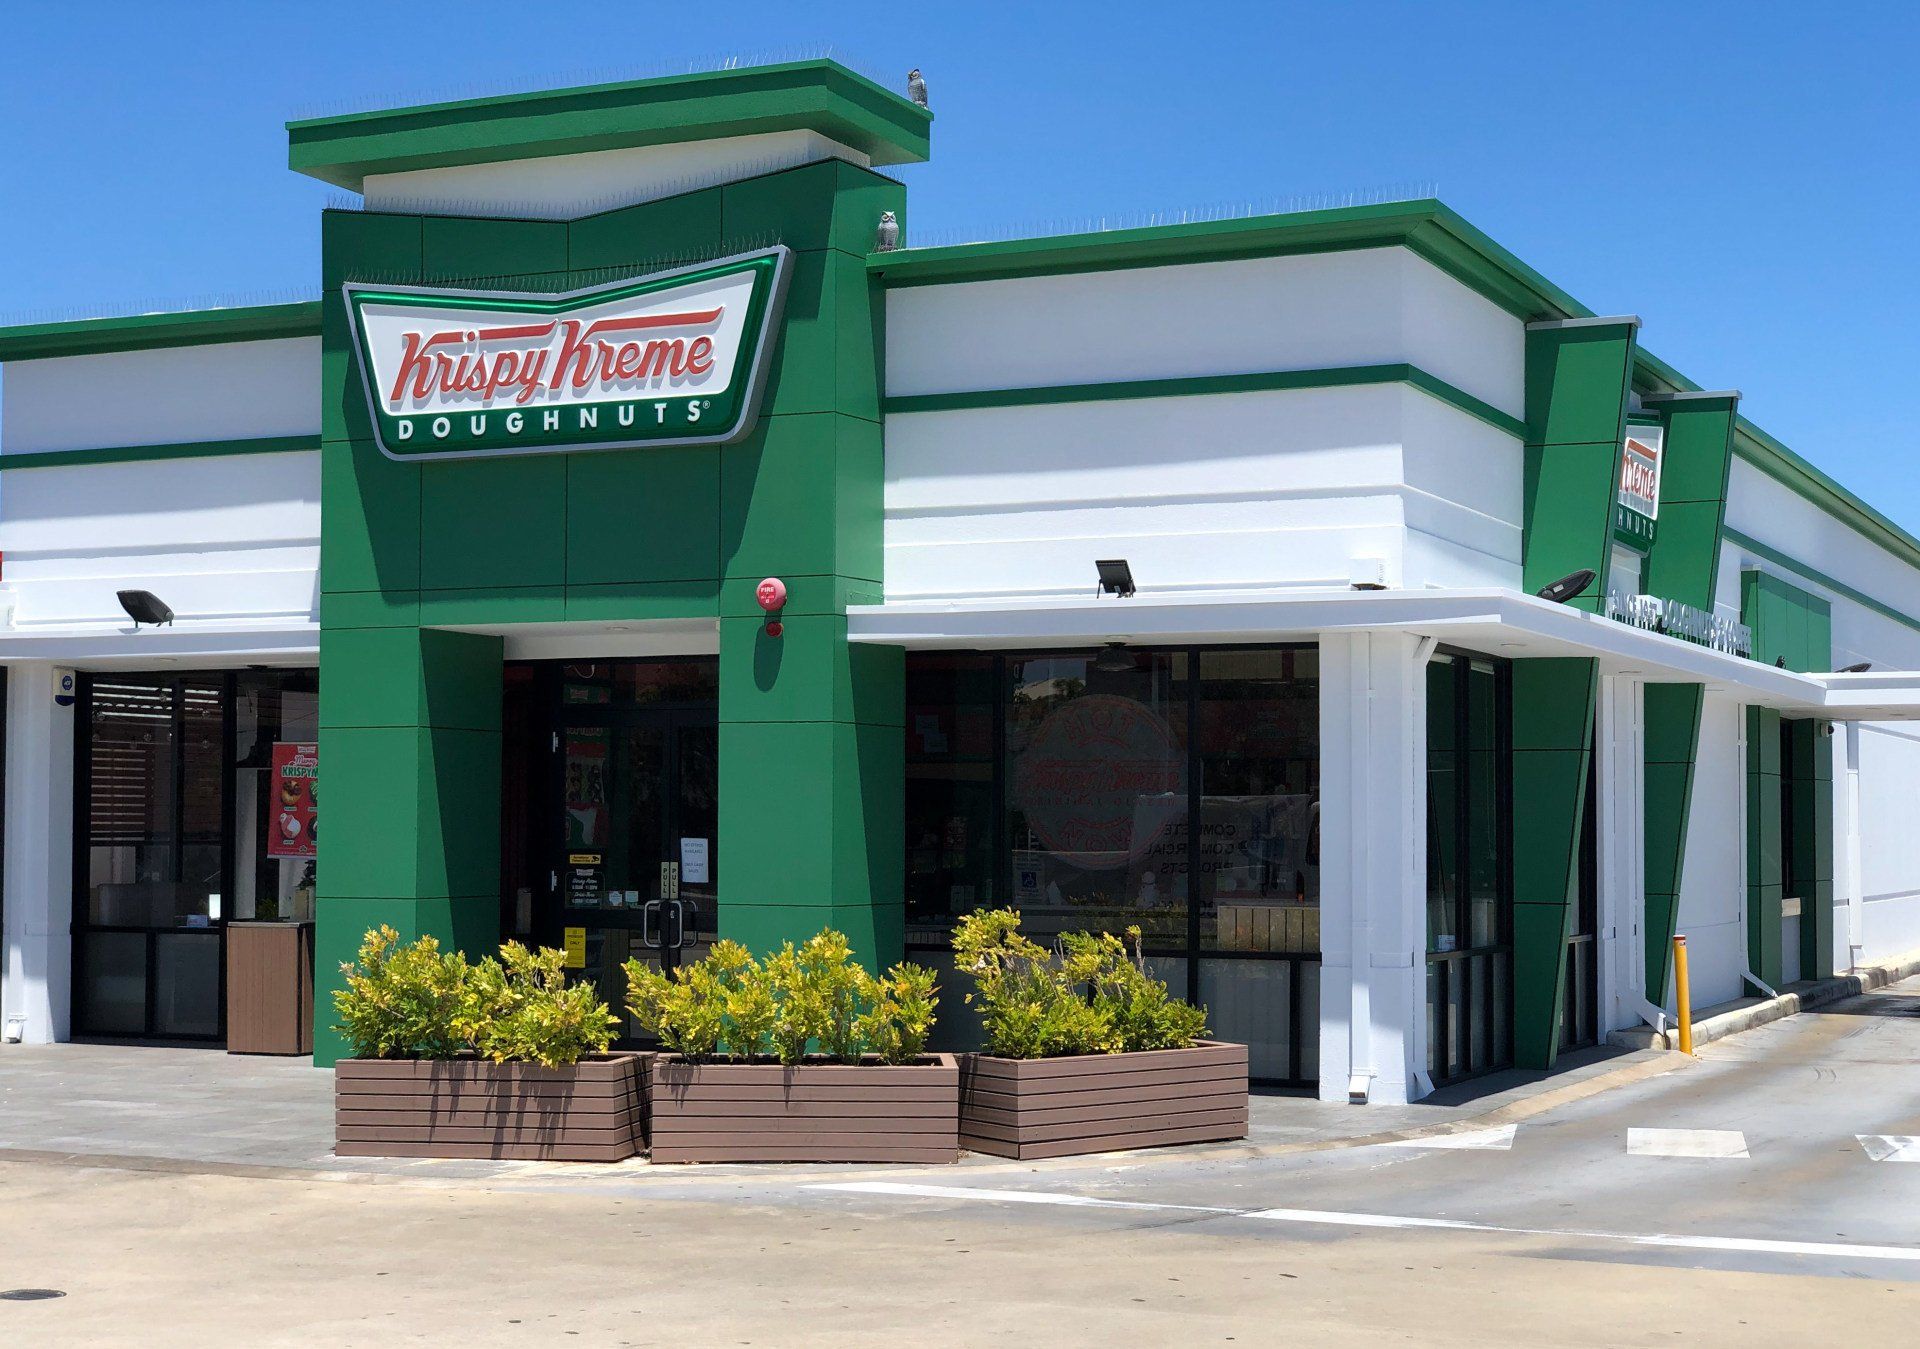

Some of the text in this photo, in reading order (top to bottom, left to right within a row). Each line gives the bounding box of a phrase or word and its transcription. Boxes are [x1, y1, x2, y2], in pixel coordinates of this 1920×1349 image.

[390, 305, 726, 404] Krispy Kreme
[1612, 589, 1637, 619] SINCE
